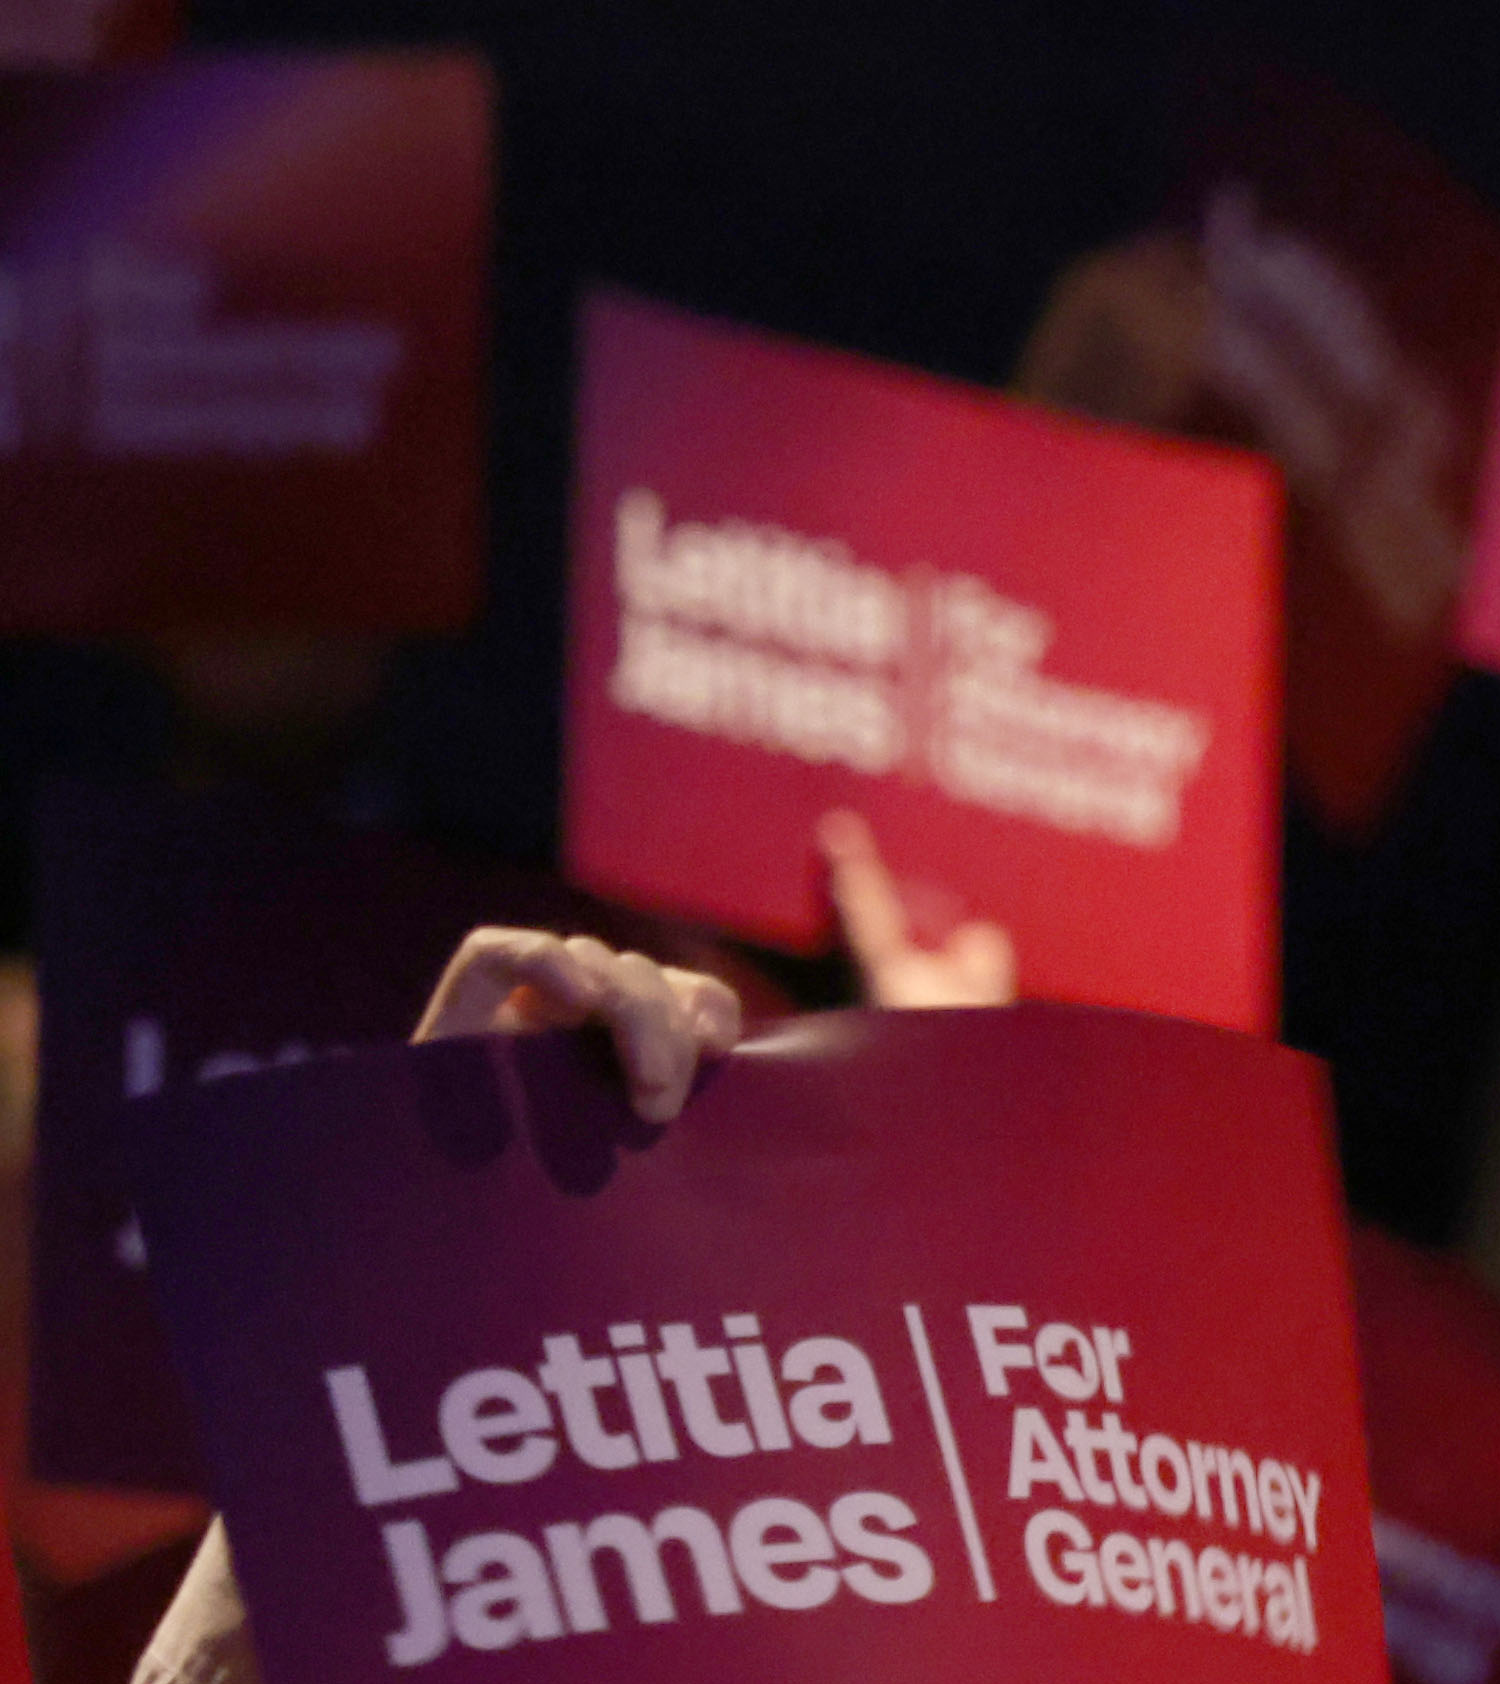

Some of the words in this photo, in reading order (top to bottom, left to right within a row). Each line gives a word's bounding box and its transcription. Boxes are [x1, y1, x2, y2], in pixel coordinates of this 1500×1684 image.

[323, 1310, 892, 1508] Letitia
[964, 1304, 1134, 1402] For
[1006, 1407, 1323, 1553] Attorney
[384, 1485, 937, 1670] James
[1022, 1510, 1320, 1656] General
